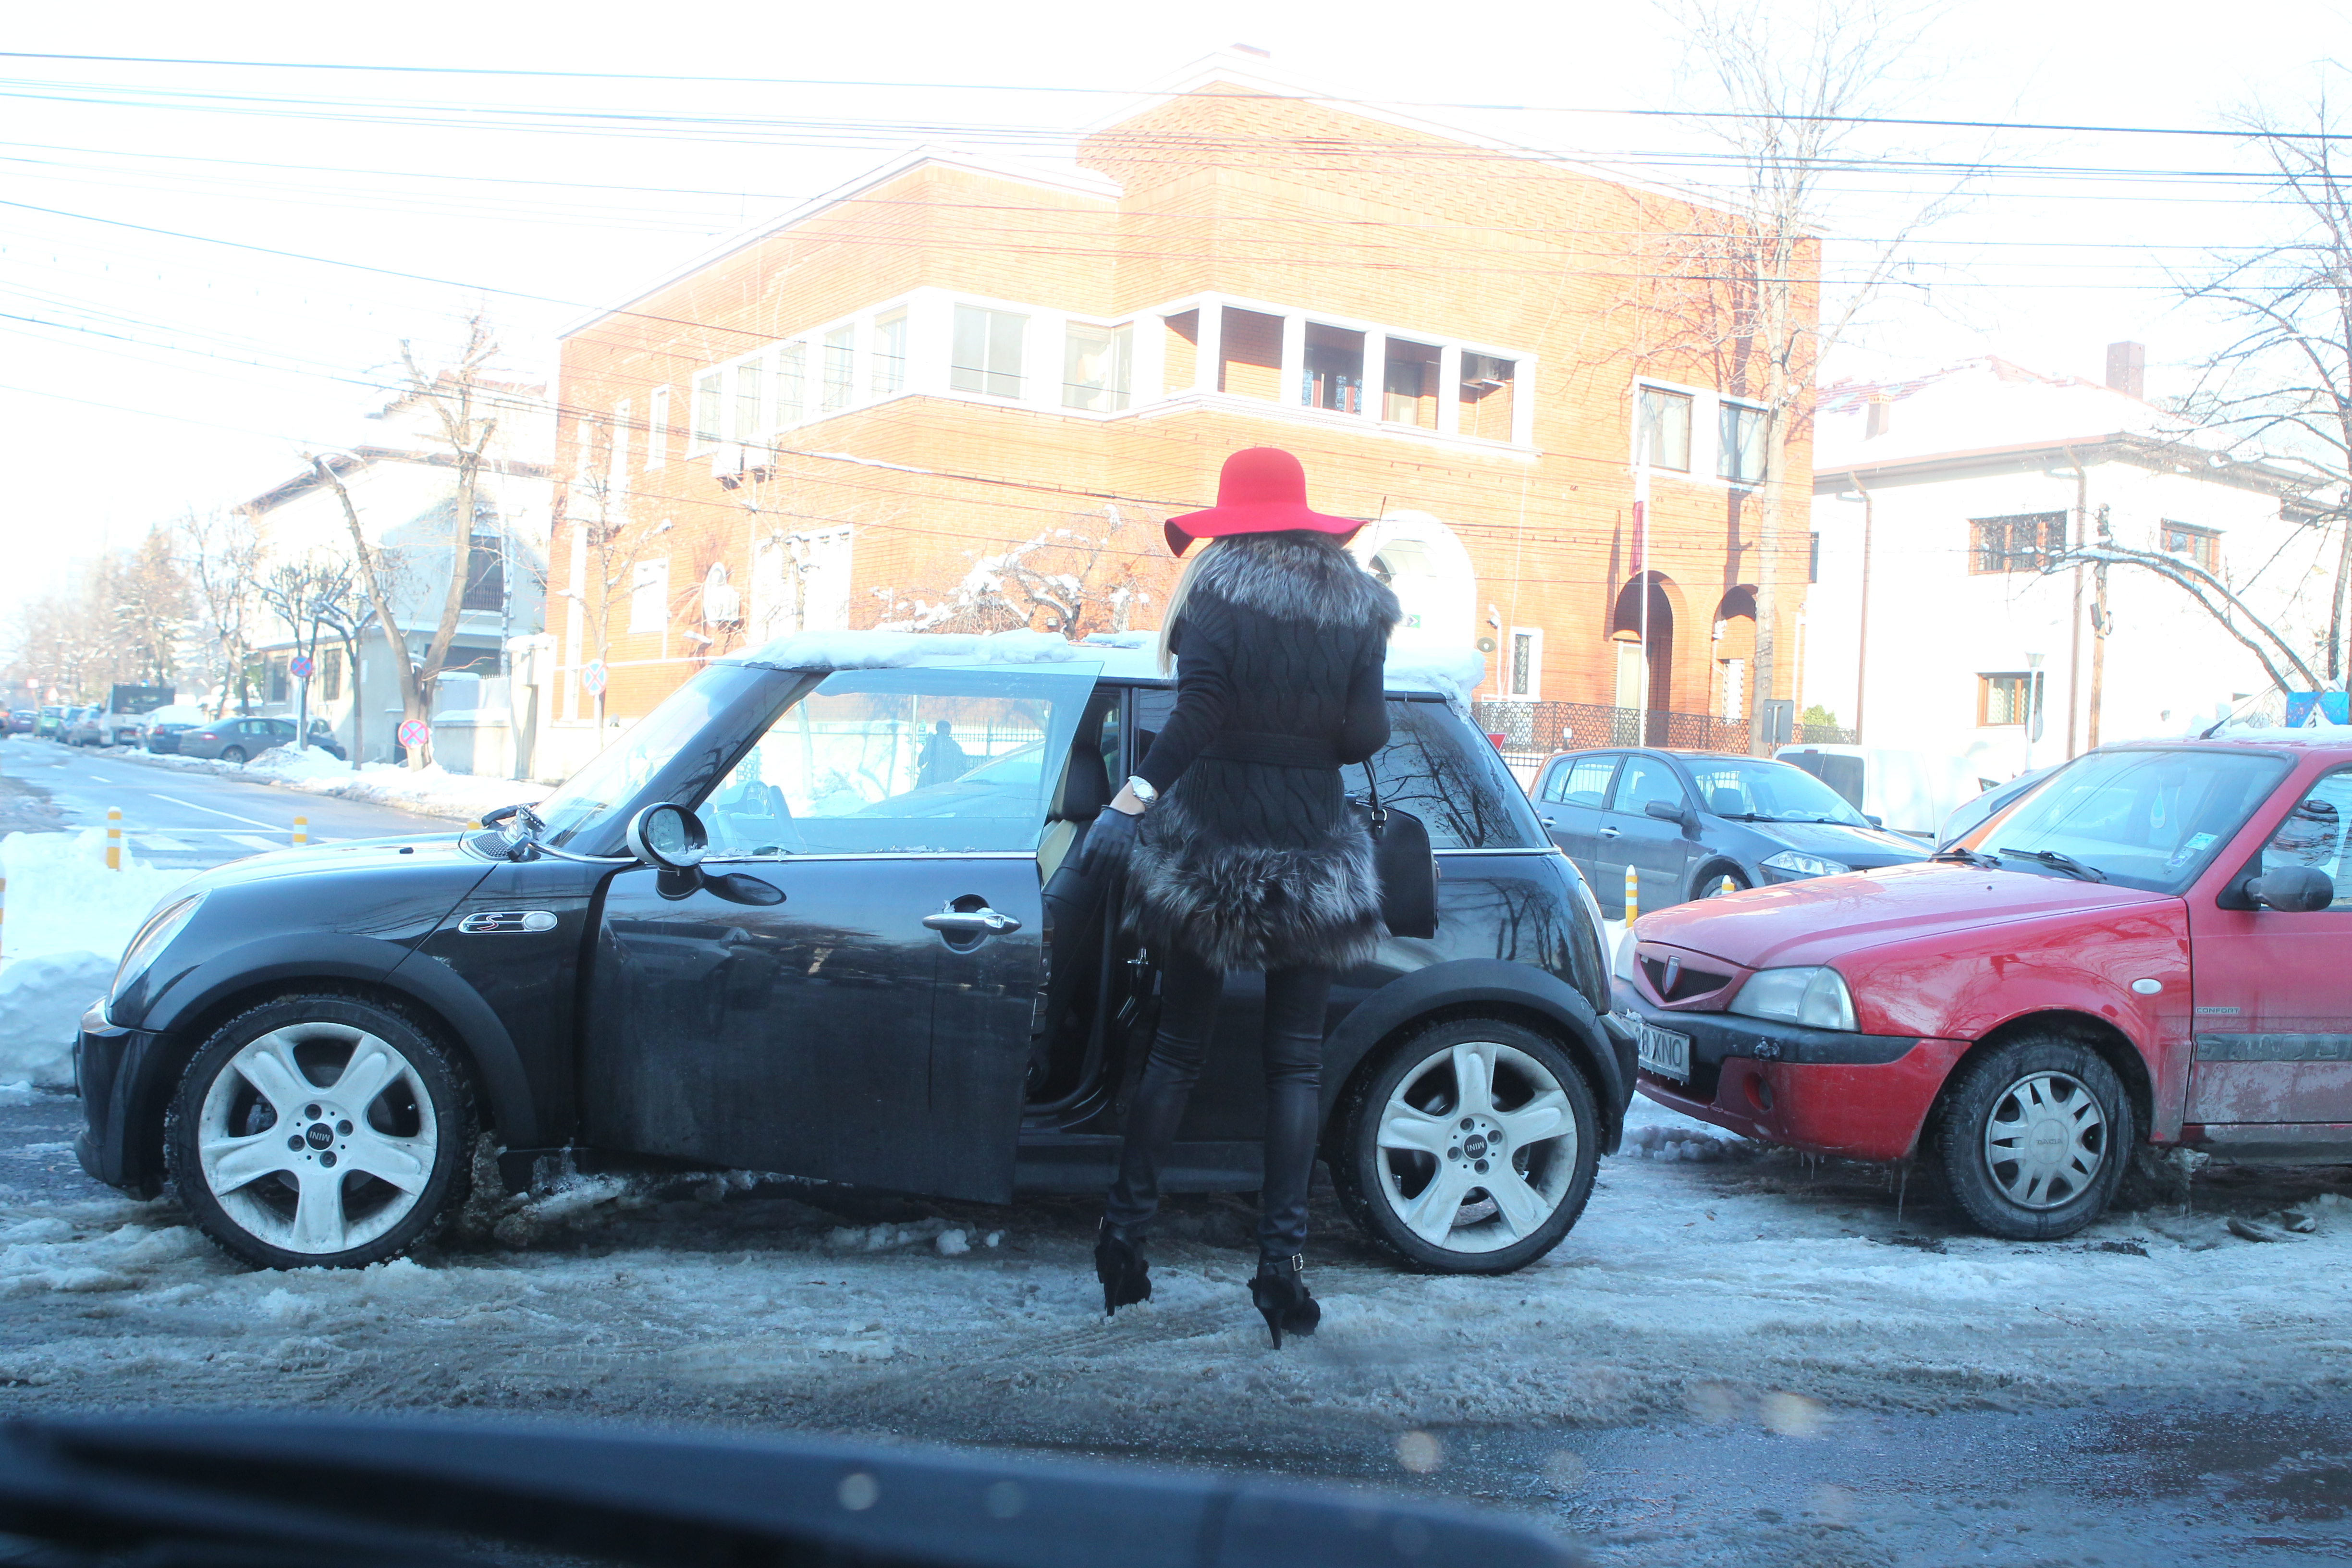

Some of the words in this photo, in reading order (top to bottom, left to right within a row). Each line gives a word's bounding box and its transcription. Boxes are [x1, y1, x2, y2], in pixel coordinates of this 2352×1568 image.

[1652, 1031, 1682, 1067] XNO
[309, 1131, 330, 1142] MINI
[1467, 1141, 1484, 1152] MINI
